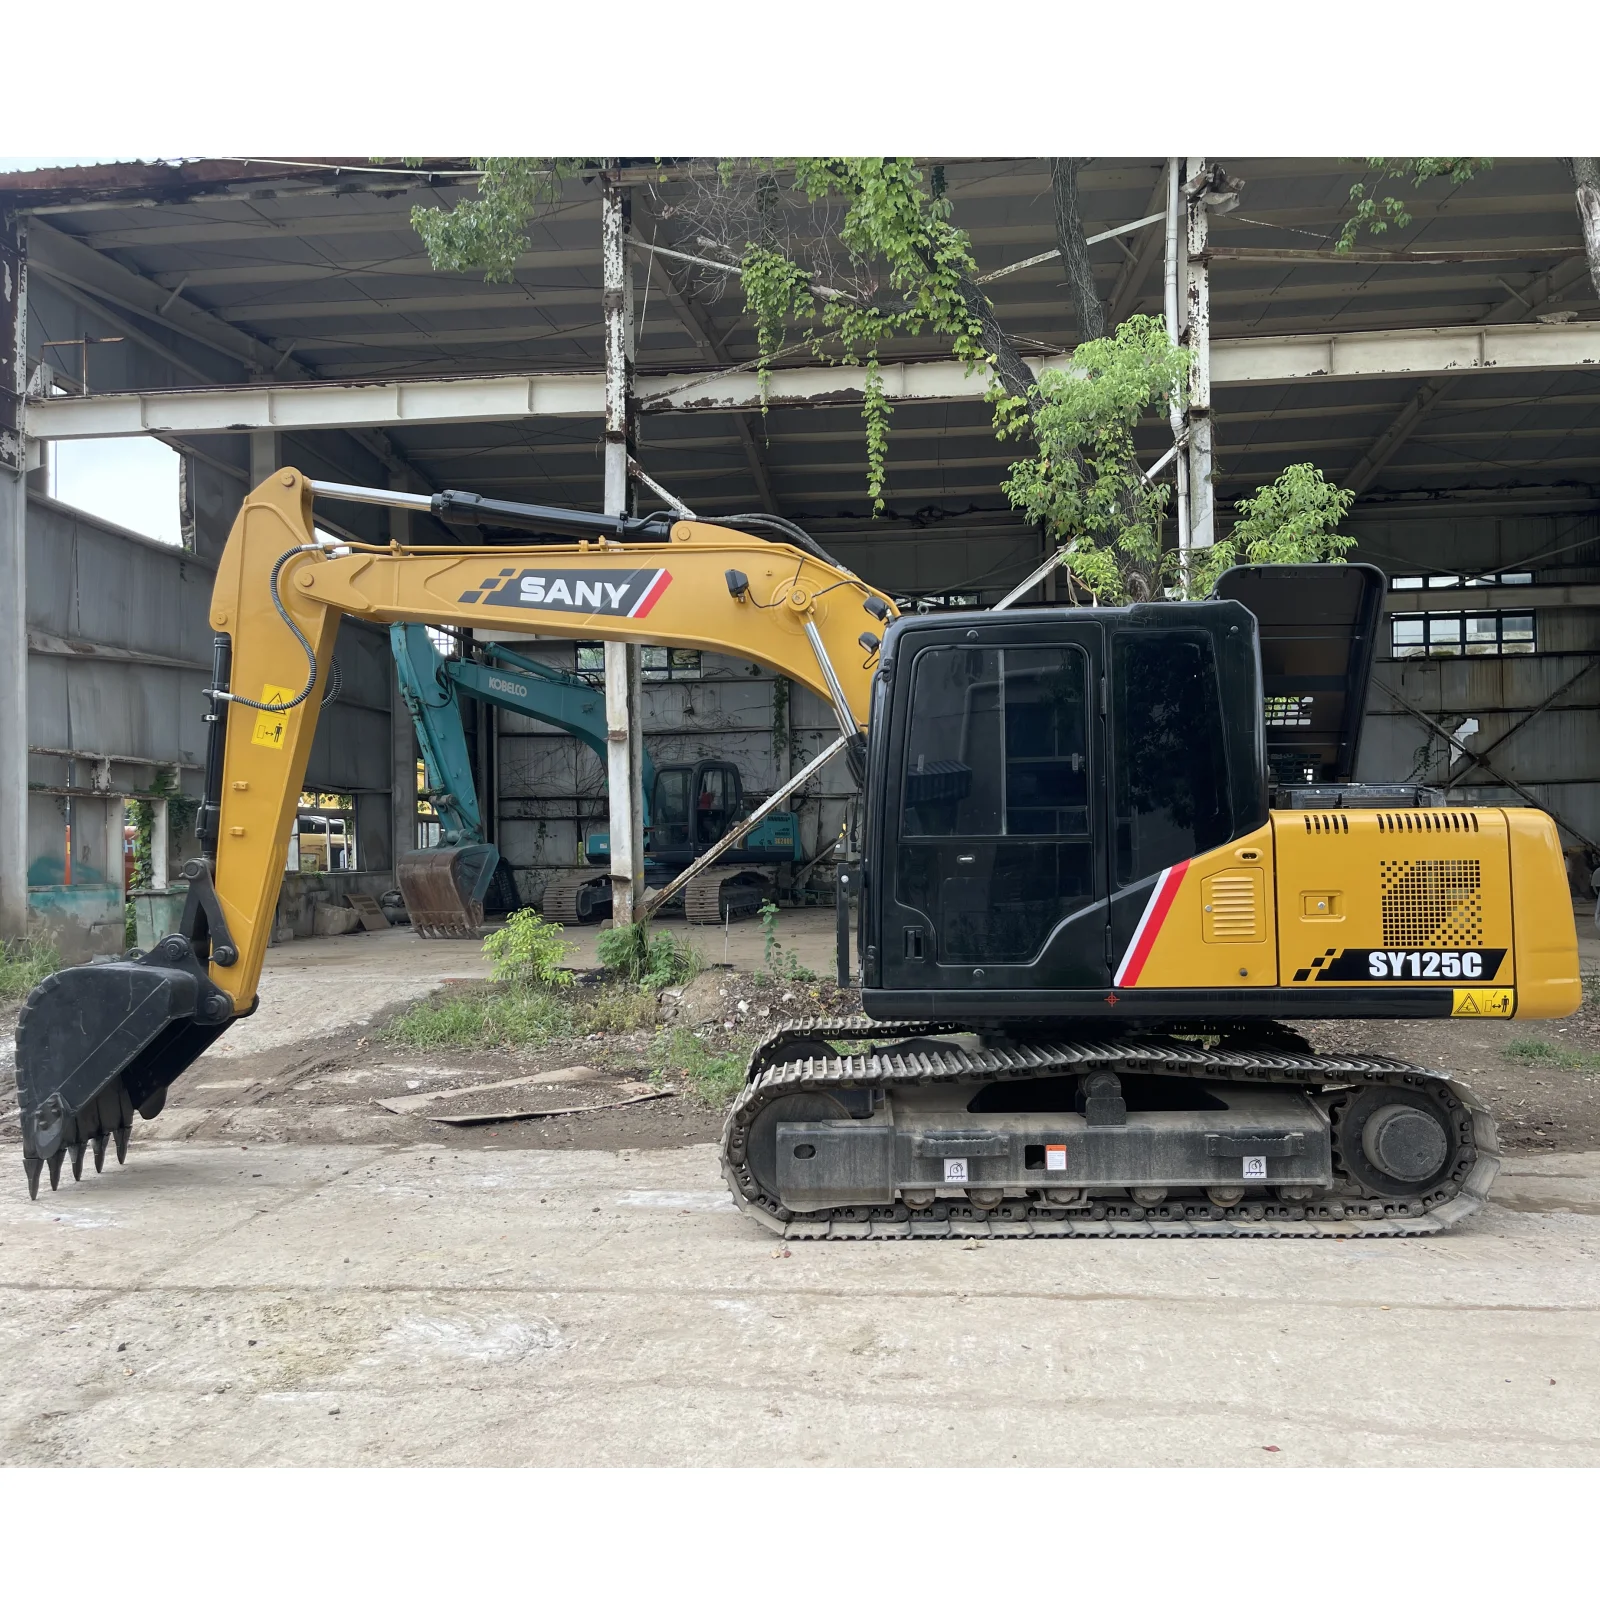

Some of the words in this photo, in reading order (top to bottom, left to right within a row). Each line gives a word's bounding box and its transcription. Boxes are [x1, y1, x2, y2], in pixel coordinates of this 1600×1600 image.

[519, 576, 631, 609] SANY
[488, 676, 528, 697] KOBELCO
[1368, 951, 1483, 978] SY125C
